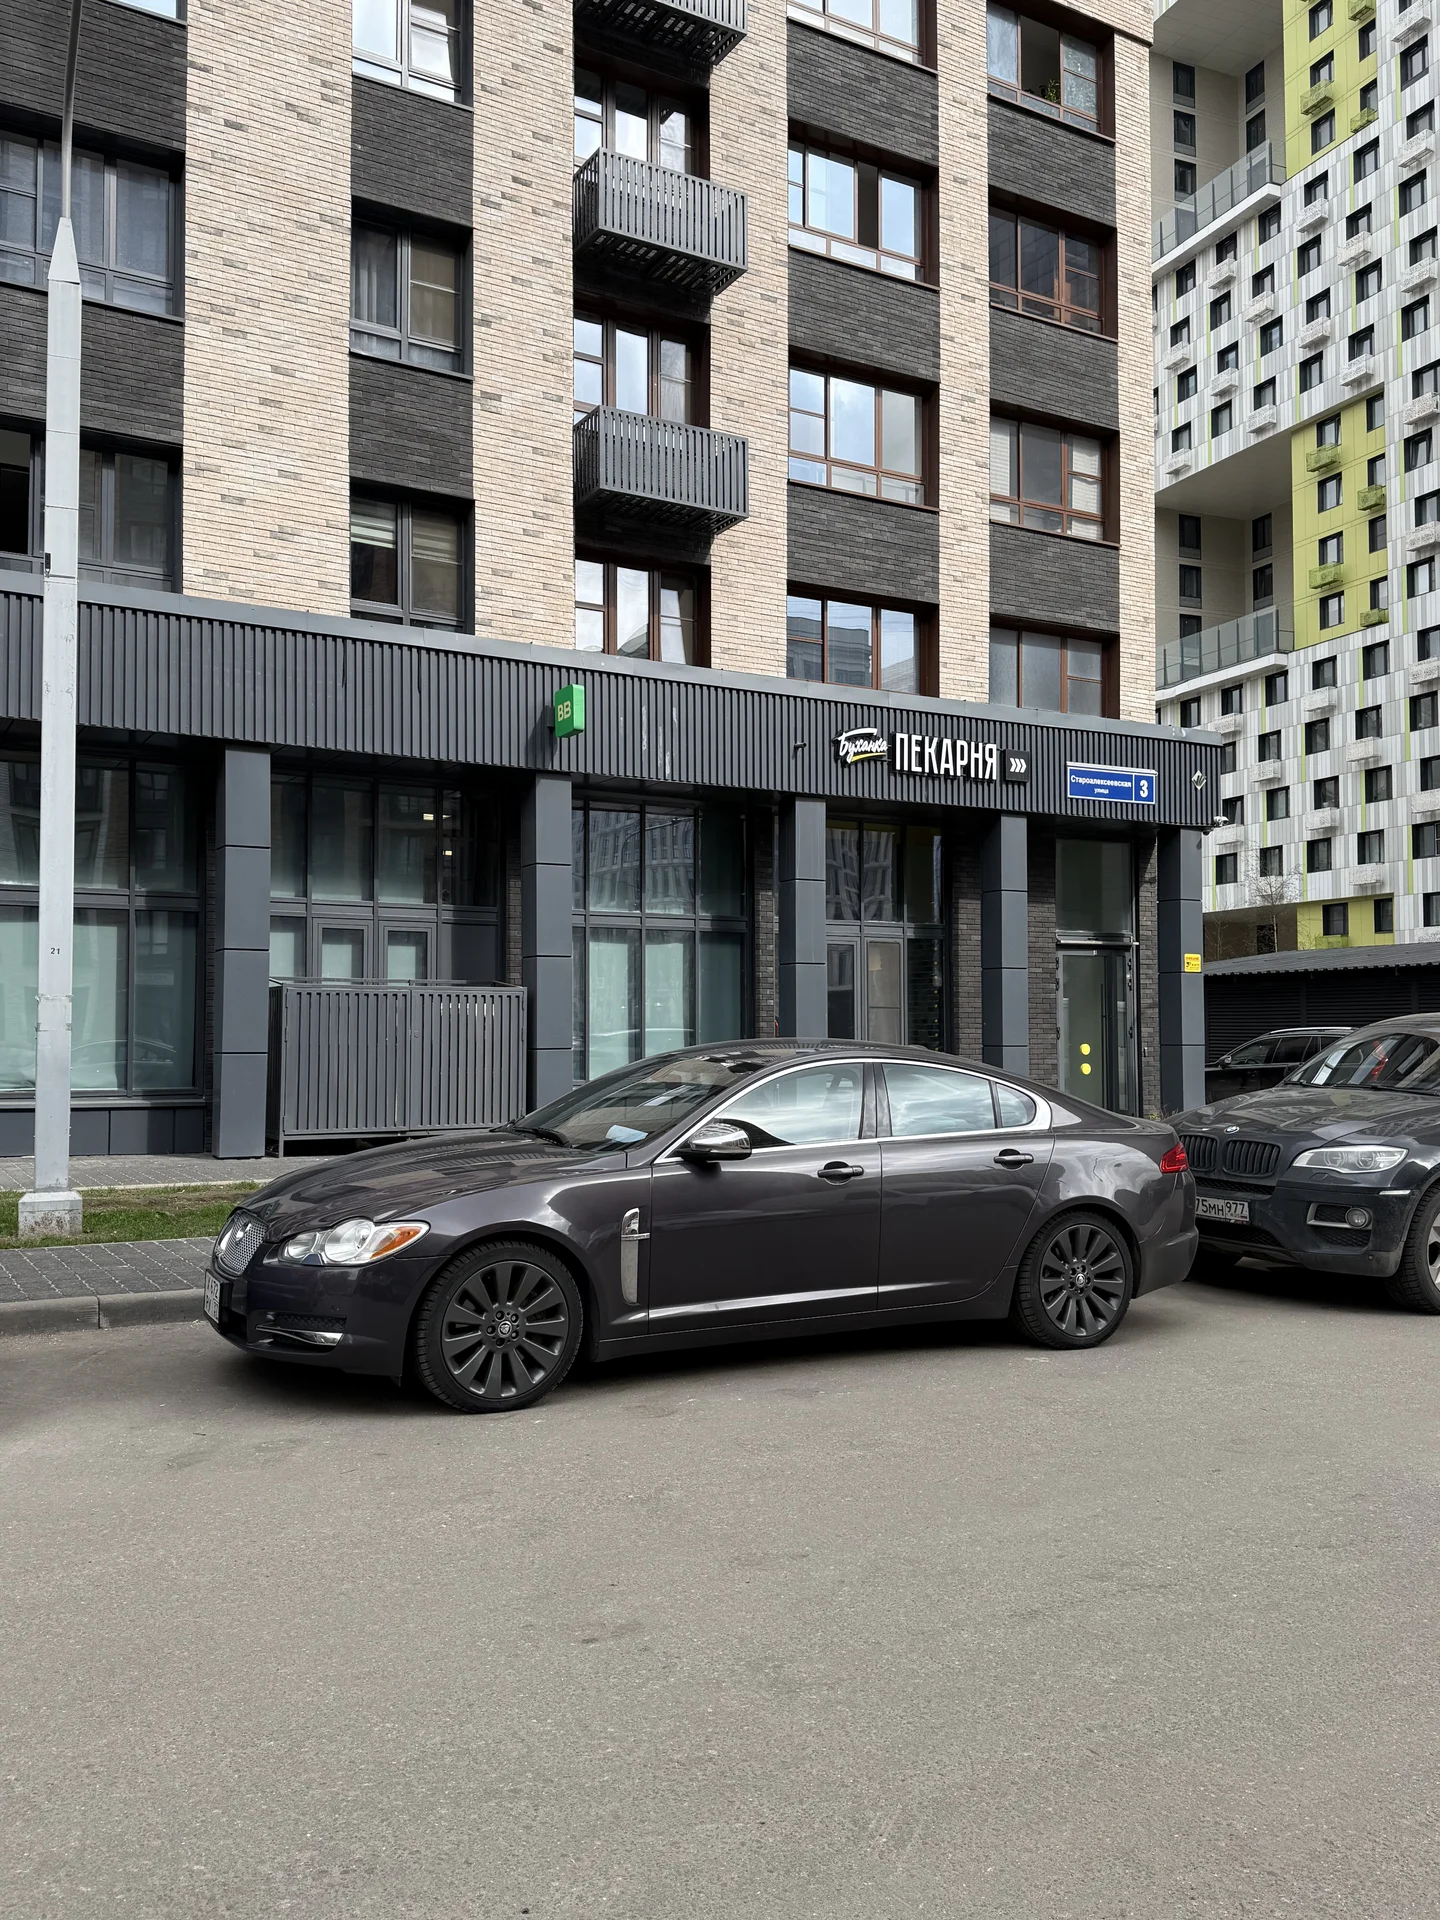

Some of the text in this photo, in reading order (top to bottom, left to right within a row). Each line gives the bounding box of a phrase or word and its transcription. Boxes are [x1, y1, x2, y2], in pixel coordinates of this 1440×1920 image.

[837, 727, 997, 780] Буханка ПЕКАРНЯ
[1070, 775, 1132, 788] Староалексеевская
[1139, 779, 1149, 798] 3
[50, 947, 61, 955] 21
[1225, 1201, 1245, 1215] 977
